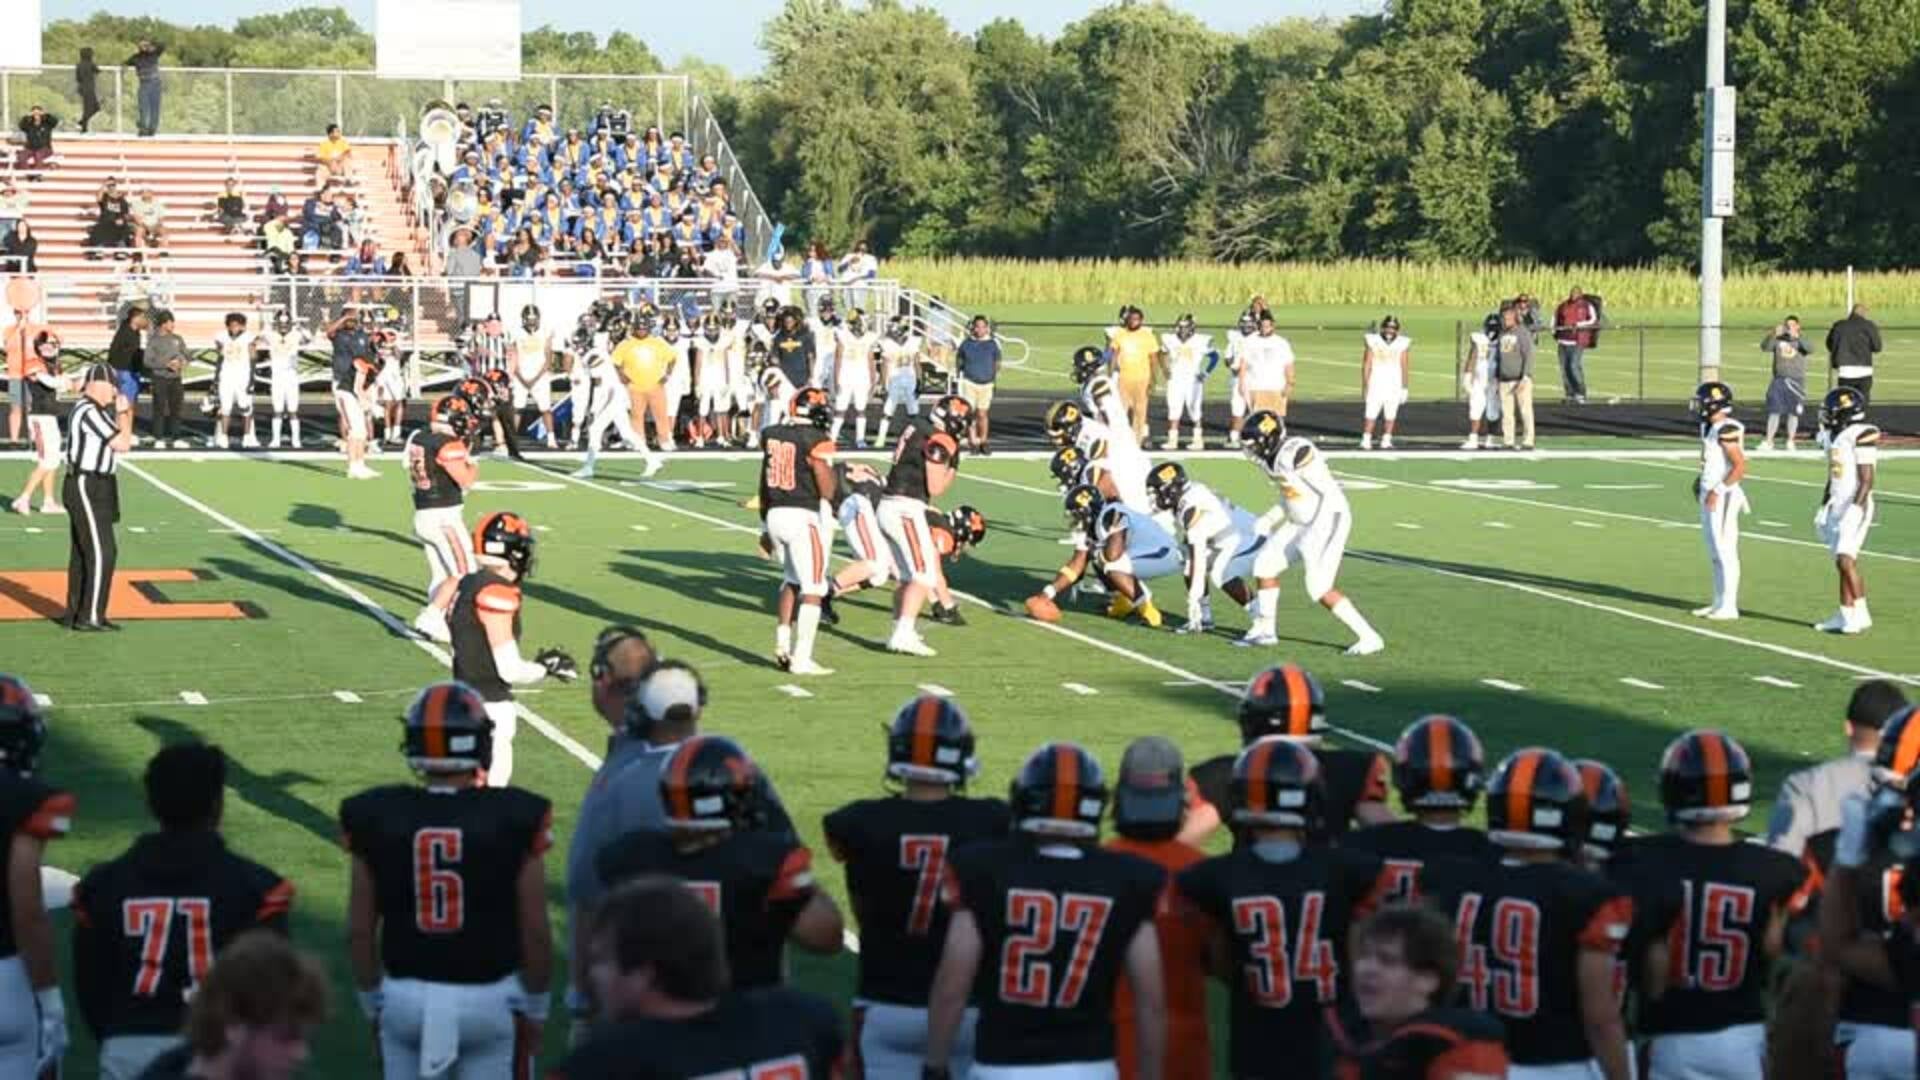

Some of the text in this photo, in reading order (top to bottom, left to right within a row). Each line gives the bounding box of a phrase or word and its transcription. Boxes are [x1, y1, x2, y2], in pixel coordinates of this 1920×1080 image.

[414, 827, 465, 934] 6
[900, 834, 951, 936] 7
[1668, 879, 1756, 991] 15
[123, 896, 213, 1004] 71
[1000, 888, 1115, 1009] 27
[1232, 890, 1338, 1010] 34
[1455, 892, 1541, 1019] 49
